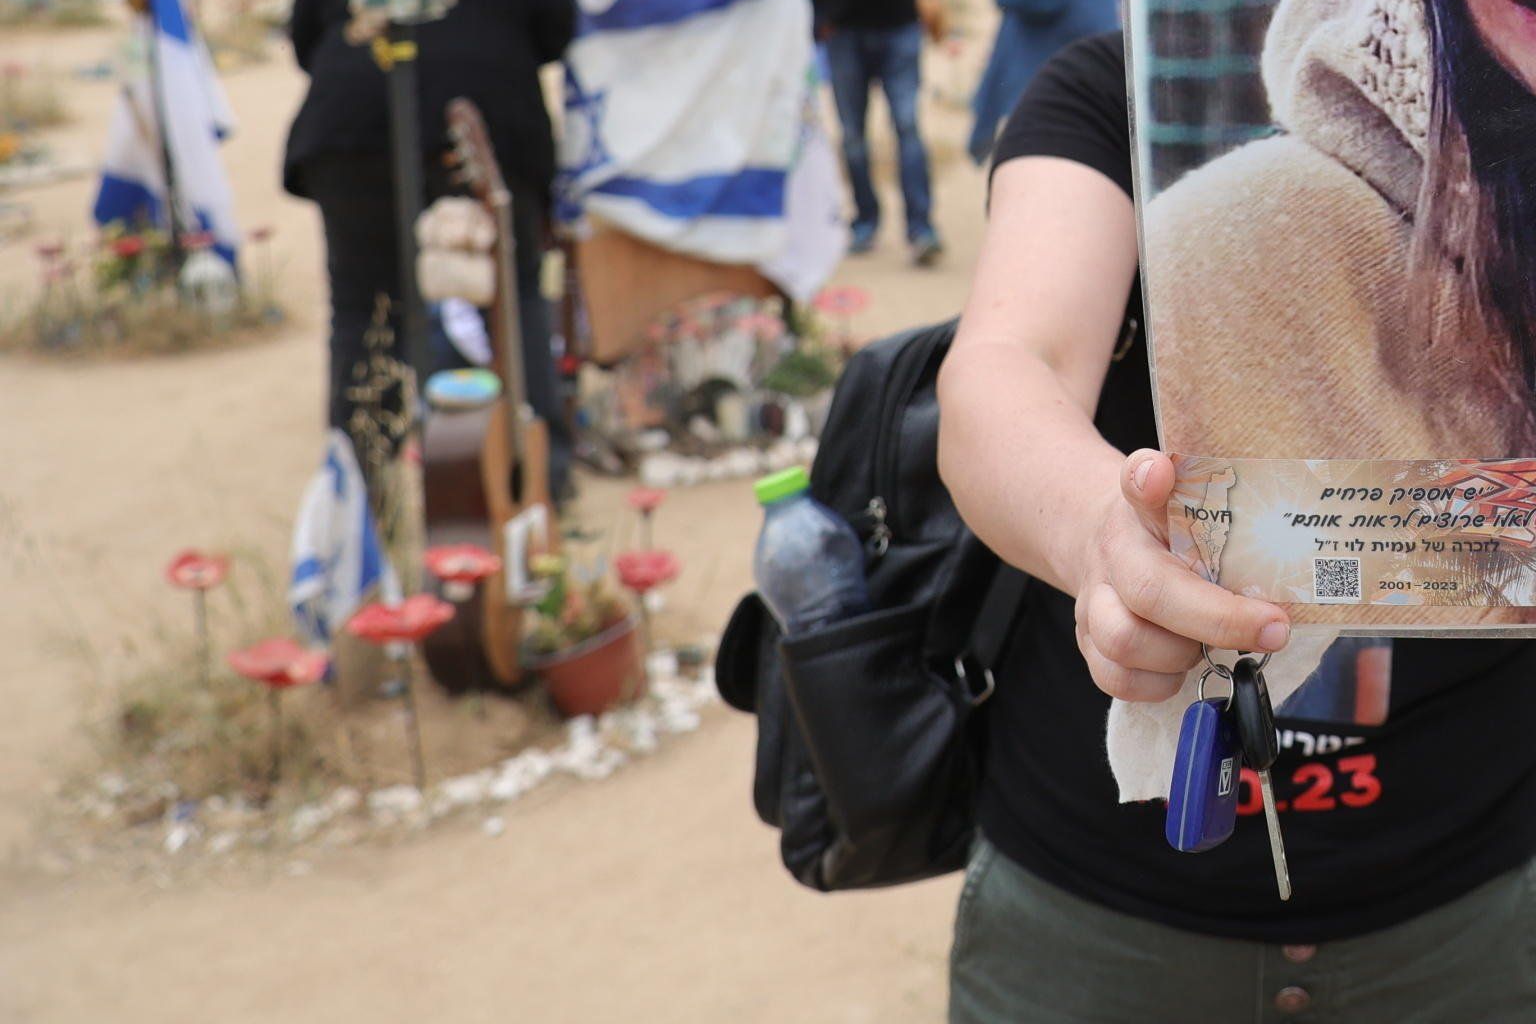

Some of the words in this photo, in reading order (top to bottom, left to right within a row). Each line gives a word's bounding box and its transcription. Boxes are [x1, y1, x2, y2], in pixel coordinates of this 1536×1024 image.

[1320, 487, 1384, 501] פרחים
[1388, 486, 1456, 506] מספיק
[1184, 504, 1233, 524] NOVA
[1348, 508, 1420, 528] לראות
[1417, 512, 1486, 528] שרוצים
[1344, 538, 1365, 553] לוי
[1371, 540, 1417, 553] עמית
[1421, 537, 1446, 553] של
[1452, 538, 1500, 553] לזכרה
